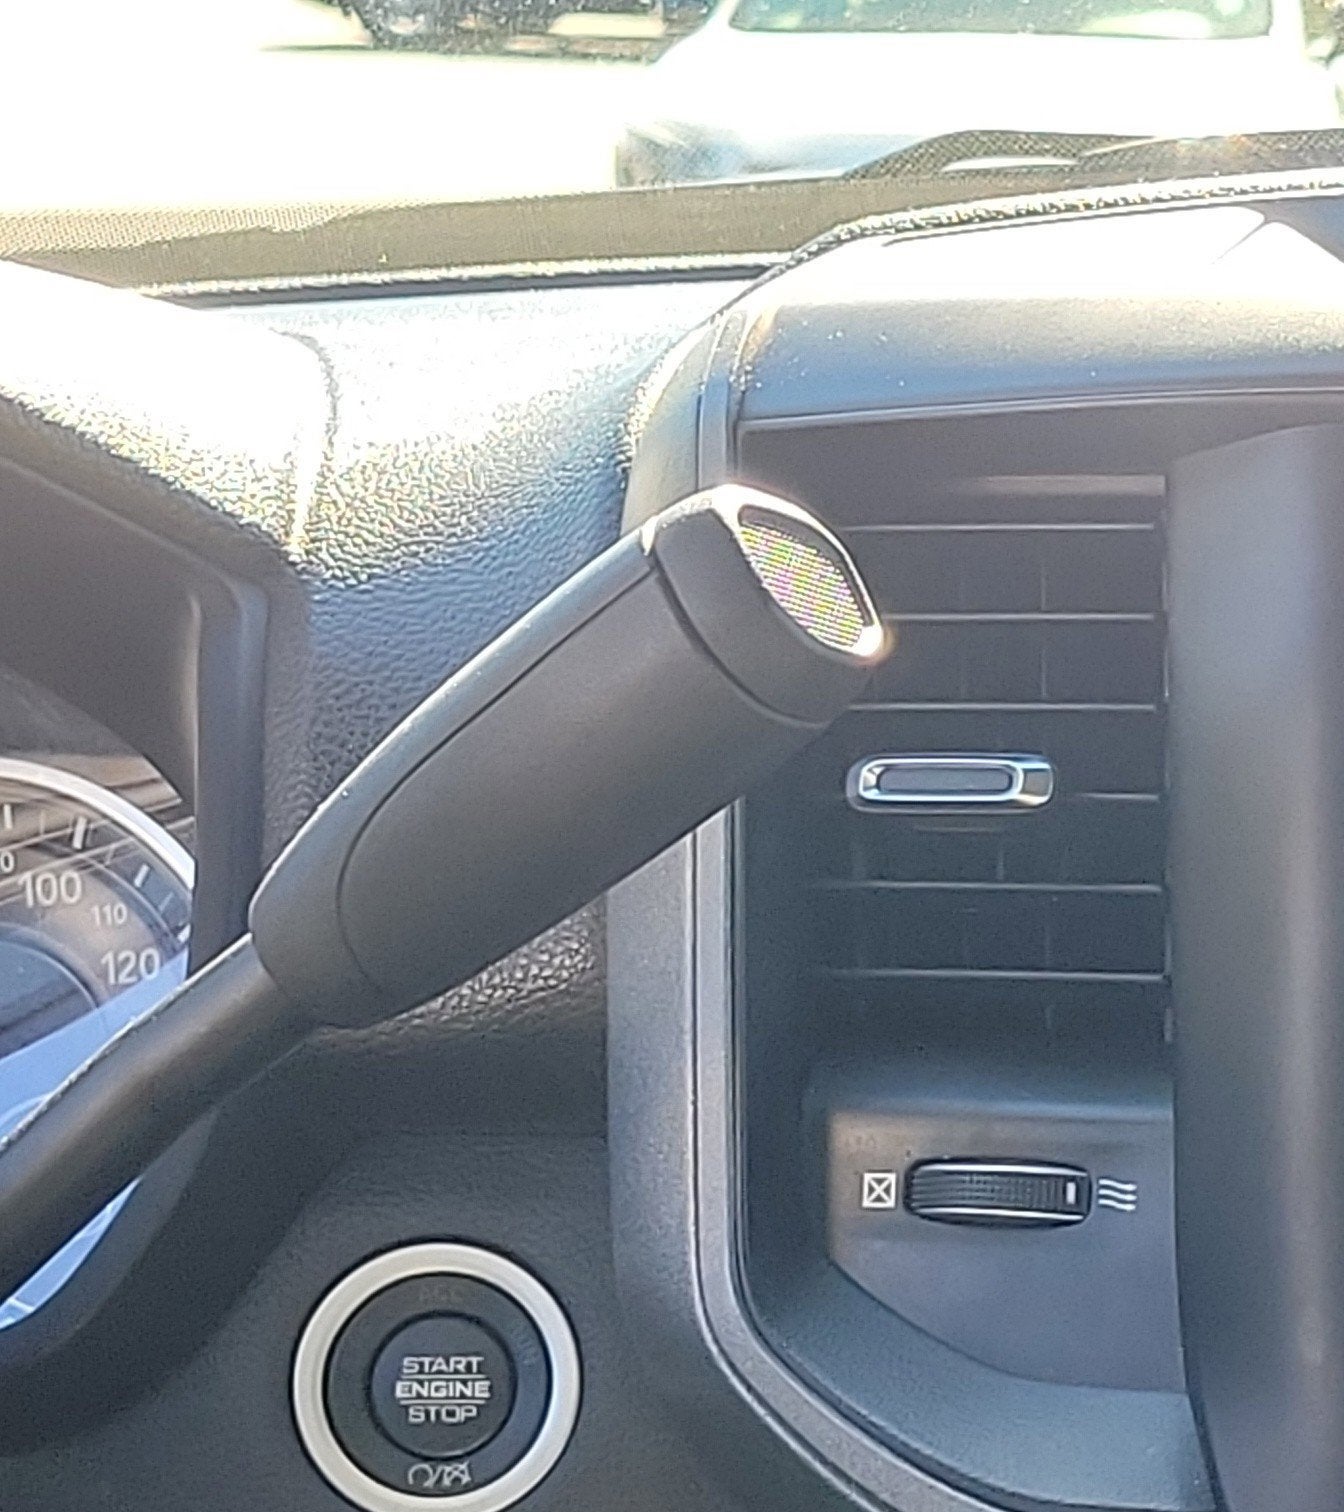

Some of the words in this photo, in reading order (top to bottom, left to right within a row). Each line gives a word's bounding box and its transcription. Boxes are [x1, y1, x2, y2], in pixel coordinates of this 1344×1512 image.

[19, 869, 83, 908] 100
[92, 902, 128, 928] 110
[101, 947, 161, 986] 120
[402, 1356, 485, 1374] START
[395, 1380, 492, 1398] ENGINE
[408, 1405, 478, 1424] STOP
